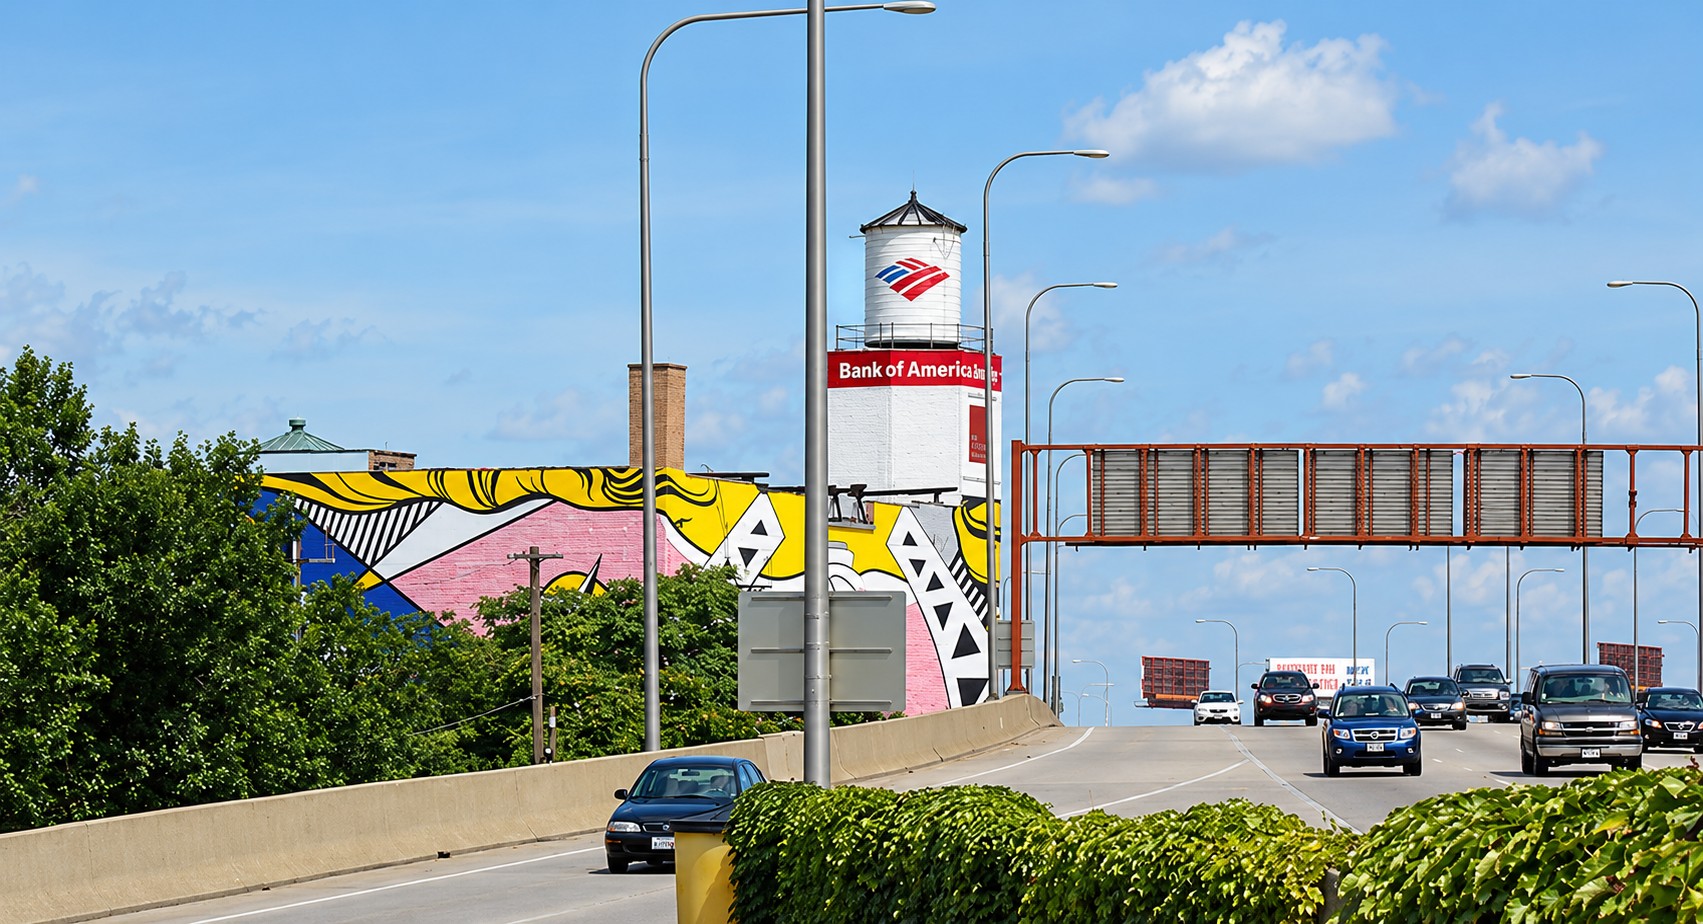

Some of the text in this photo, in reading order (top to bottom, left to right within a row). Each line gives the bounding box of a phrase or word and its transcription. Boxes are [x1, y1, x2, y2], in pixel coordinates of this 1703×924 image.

[839, 361, 882, 379] Bank
[885, 360, 904, 377] of
[907, 360, 972, 378] America
